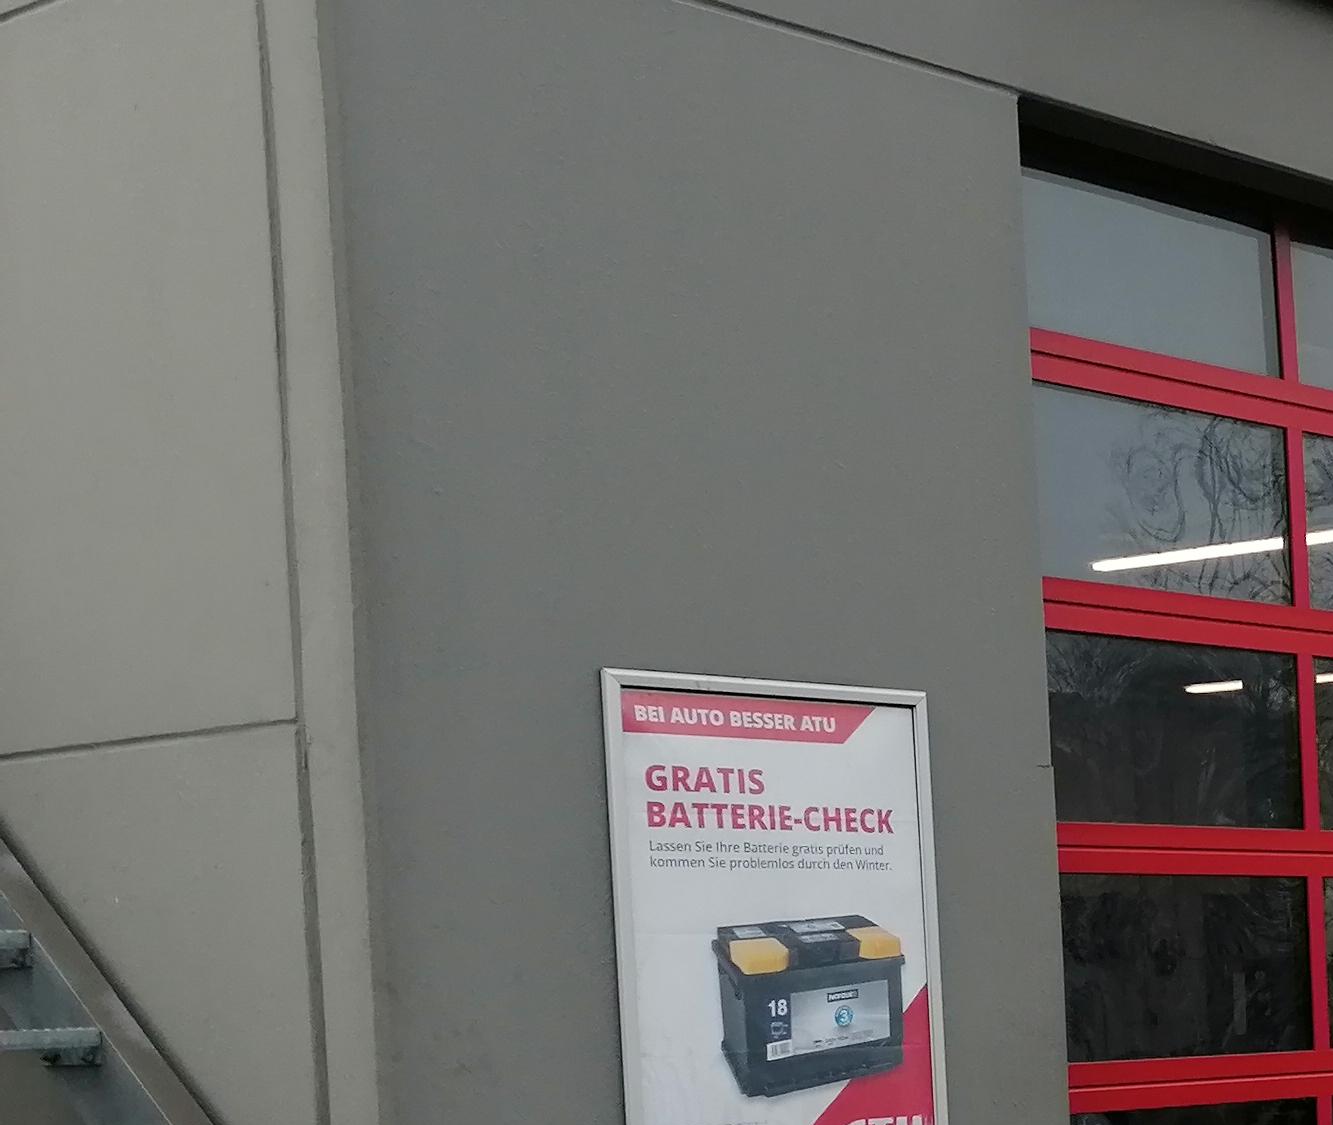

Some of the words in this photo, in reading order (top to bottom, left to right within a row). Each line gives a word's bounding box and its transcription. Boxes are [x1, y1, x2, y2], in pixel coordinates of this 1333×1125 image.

[634, 704, 665, 723] BEI
[671, 708, 724, 727] AUTO
[730, 711, 796, 731] BESSER
[800, 714, 836, 733] ATU
[645, 764, 765, 795] GRATIS
[646, 801, 894, 834] BATTERIE-CHECK
[649, 840, 691, 852] Lassen
[695, 841, 713, 853] Sie
[716, 841, 740, 853] Ihre
[744, 842, 790, 854] Batterie
[792, 844, 824, 857] gratis
[826, 844, 861, 858] prüfen
[864, 845, 884, 857] und
[650, 856, 705, 868] kommen
[709, 856, 726, 869] Sie
[730, 857, 795, 871] problemlos
[798, 858, 830, 870] durch
[833, 859, 853, 870] den
[855, 859, 893, 871] Winter.
[768, 999, 788, 1018] 18
[838, 1008, 849, 1023] 3
